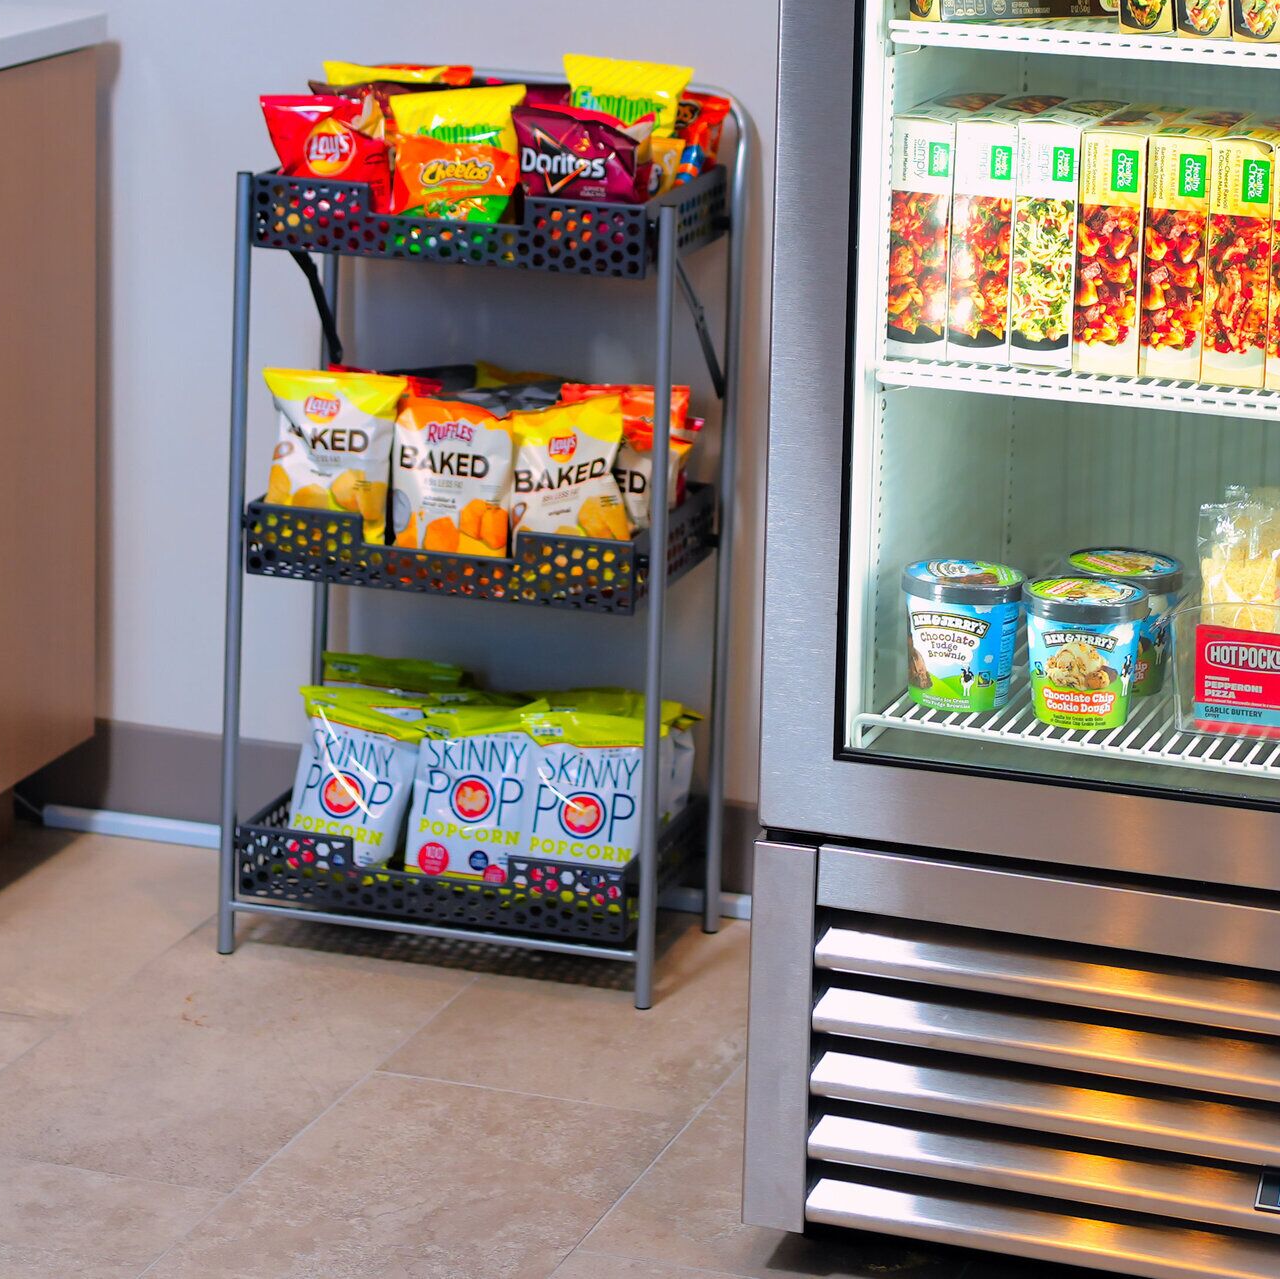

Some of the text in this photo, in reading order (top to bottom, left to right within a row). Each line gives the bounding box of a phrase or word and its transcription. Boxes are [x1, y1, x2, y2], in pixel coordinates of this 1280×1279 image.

[421, 161, 493, 185] Cheetos
[521, 146, 606, 179] Doritos
[1185, 157, 1195, 192] Choice
[1192, 162, 1202, 192] Healthy
[427, 421, 475, 445] RUFFLES
[400, 445, 490, 478] BAKED
[514, 457, 607, 493] BAKED
[920, 632, 976, 648] Chocolate
[931, 642, 958, 652] Fudge
[928, 650, 966, 662] Brownie
[1210, 644, 1239, 667] HOT
[1043, 690, 1115, 703] Chocolate Chip
[1204, 681, 1262, 695] PEPPERONI
[1204, 690, 1236, 699] PIZZA
[1046, 700, 1111, 714] Cookie Dough
[1204, 706, 1262, 718] GARLIC BUTTERY
[427, 737, 527, 775] SKINNY
[546, 755, 640, 791] SKINNY
[423, 769, 523, 826] POP
[533, 783, 636, 842] POP
[420, 818, 521, 845] POPCORN
[529, 836, 633, 864] POPCORN
